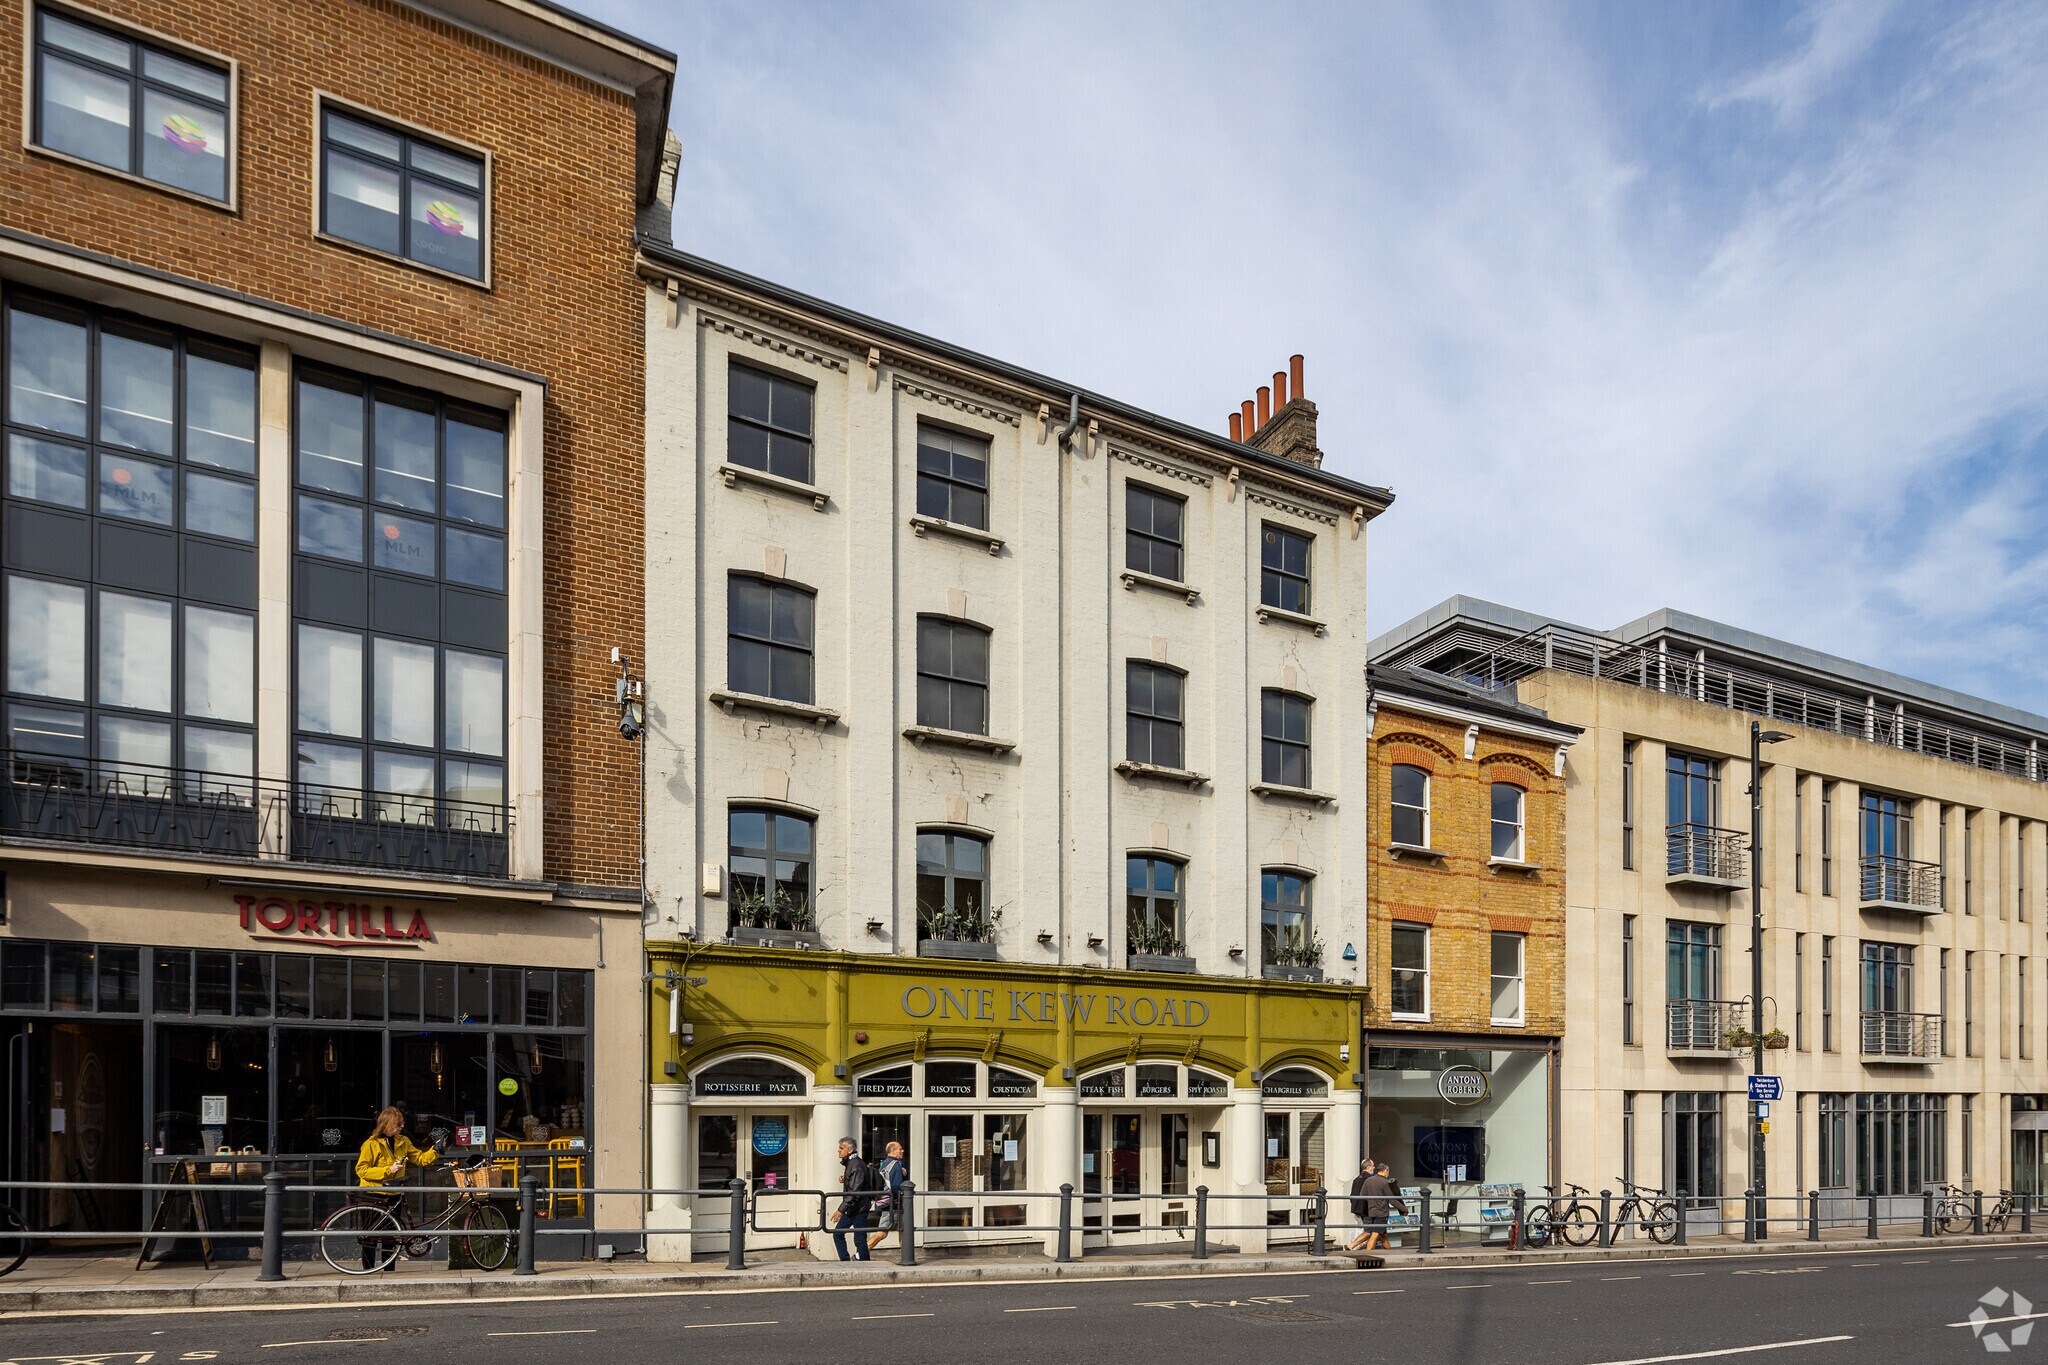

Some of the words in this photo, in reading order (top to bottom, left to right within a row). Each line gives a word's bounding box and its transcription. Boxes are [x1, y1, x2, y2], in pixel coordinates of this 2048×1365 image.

[234, 895, 431, 939] TORTILLA
[901, 985, 994, 1021] ONE
[1007, 989, 1096, 1025] KEW
[1105, 995, 1209, 1027] ROAD
[1447, 1075, 1481, 1085] ANTONY
[704, 1083, 761, 1092] ROTISSERIE
[769, 1083, 798, 1092] PASTA
[858, 1084, 885, 1094] FIRED
[886, 1085, 912, 1094] PIZZA
[930, 1085, 971, 1094] RISOTTOS
[992, 1086, 1031, 1094] CRUSTACEA
[1081, 1086, 1105, 1094] STEAK
[1108, 1086, 1124, 1094] FISH
[1142, 1086, 1172, 1094] BURGERS
[1188, 1086, 1202, 1094] SPIT
[1203, 1086, 1227, 1094] ROASTS
[1446, 1085, 1481, 1094] ROBERTS
[1427, 1142, 1468, 1152] ANTONY
[1427, 1153, 1468, 1164] ROBERTS
